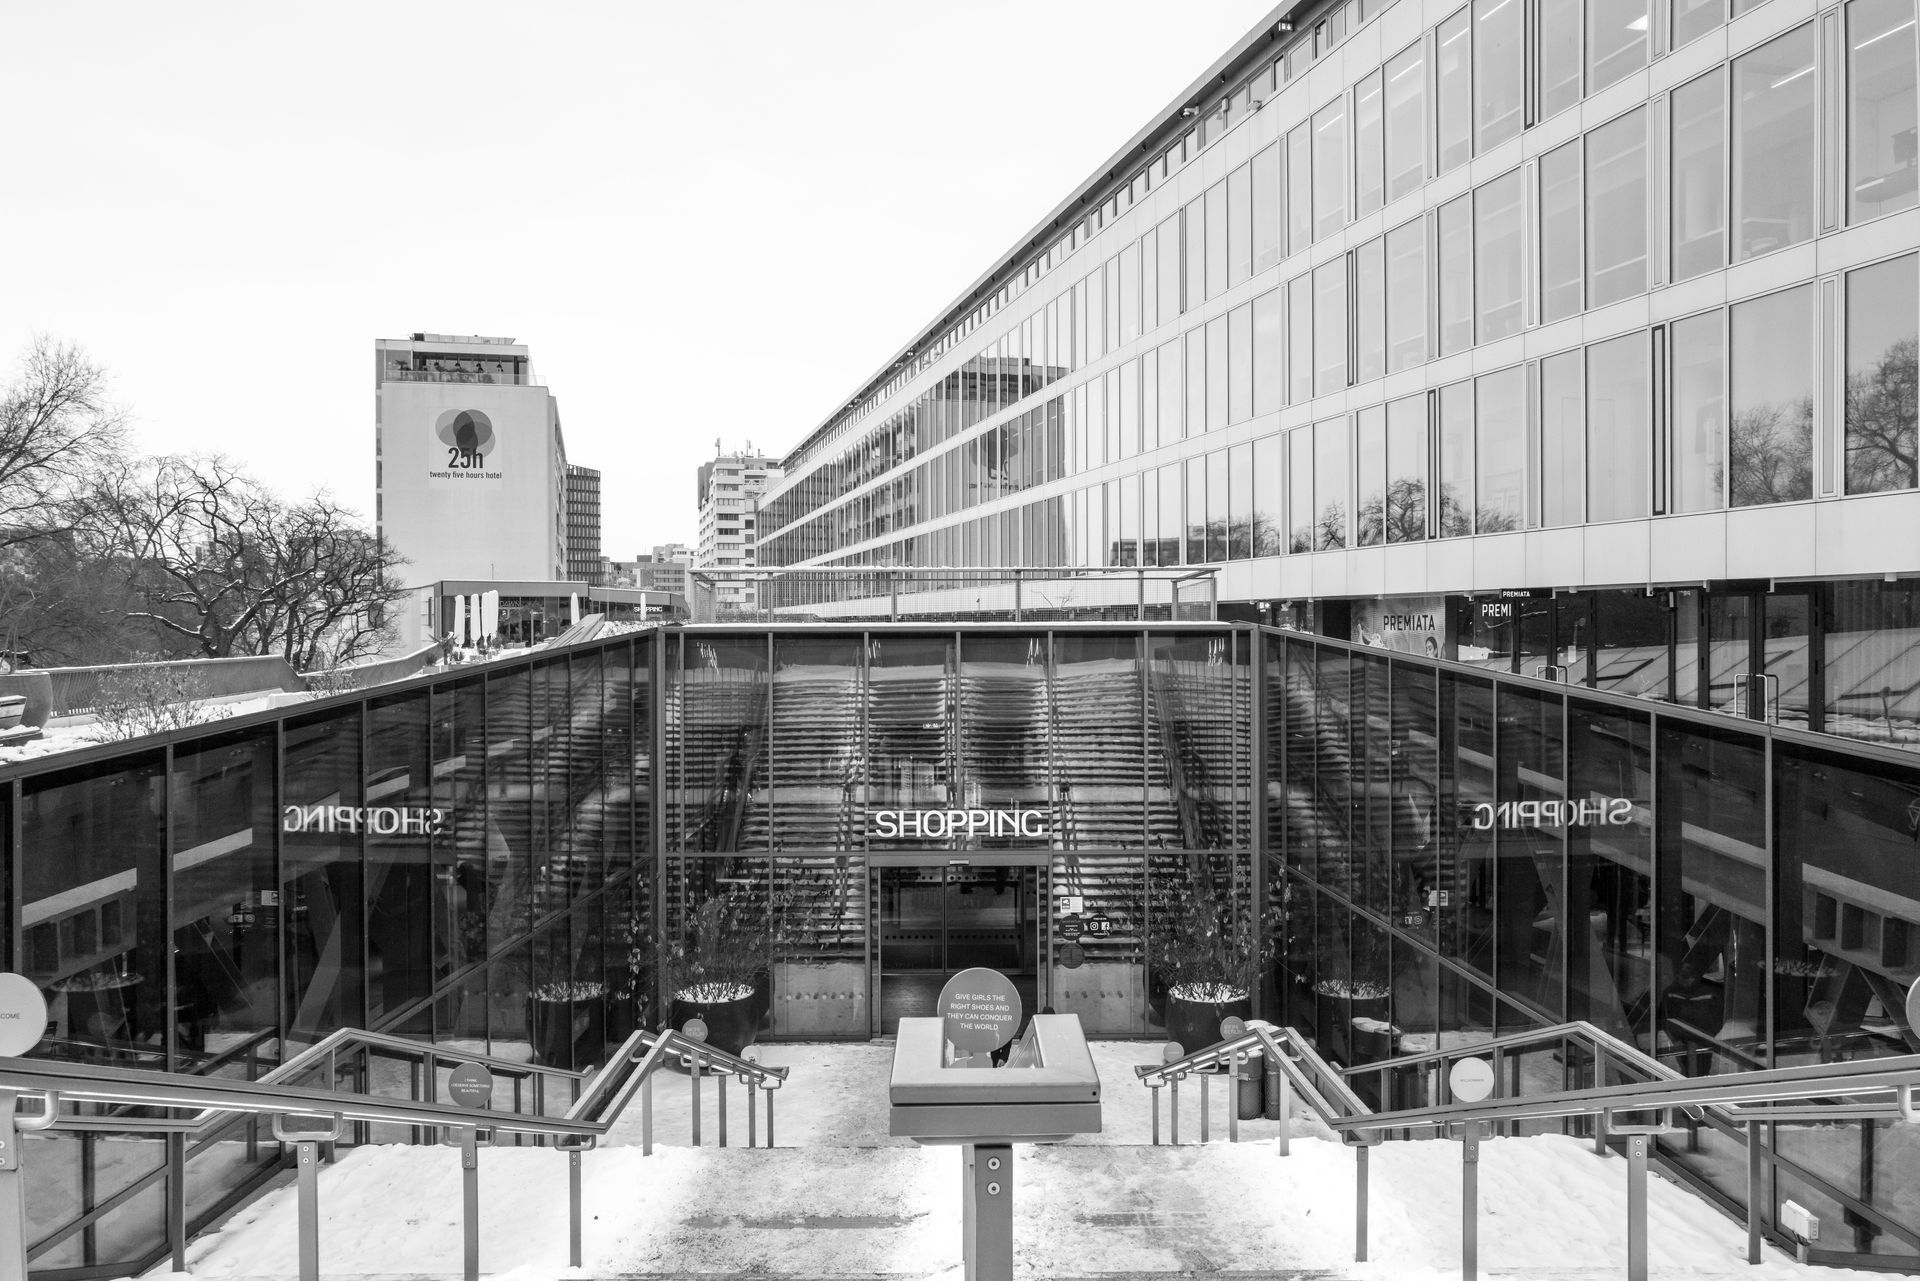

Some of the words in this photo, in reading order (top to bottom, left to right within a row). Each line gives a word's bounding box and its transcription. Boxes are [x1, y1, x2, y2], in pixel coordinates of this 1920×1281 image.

[448, 447, 483, 468] 25h
[429, 471, 451, 479] twenty
[452, 471, 465, 479] five
[1481, 604, 1512, 617] PREMI
[1383, 615, 1436, 631] PREMIATA
[875, 809, 1043, 838] SHOPPING
[955, 993, 971, 1001] GIVE
[992, 994, 1006, 1002] THE
[995, 1004, 1010, 1012] AND
[946, 1012, 964, 1020] THEY
[979, 1013, 1013, 1022] CONQUER
[960, 1022, 974, 1030] THE
[974, 1023, 999, 1031] WORLD
